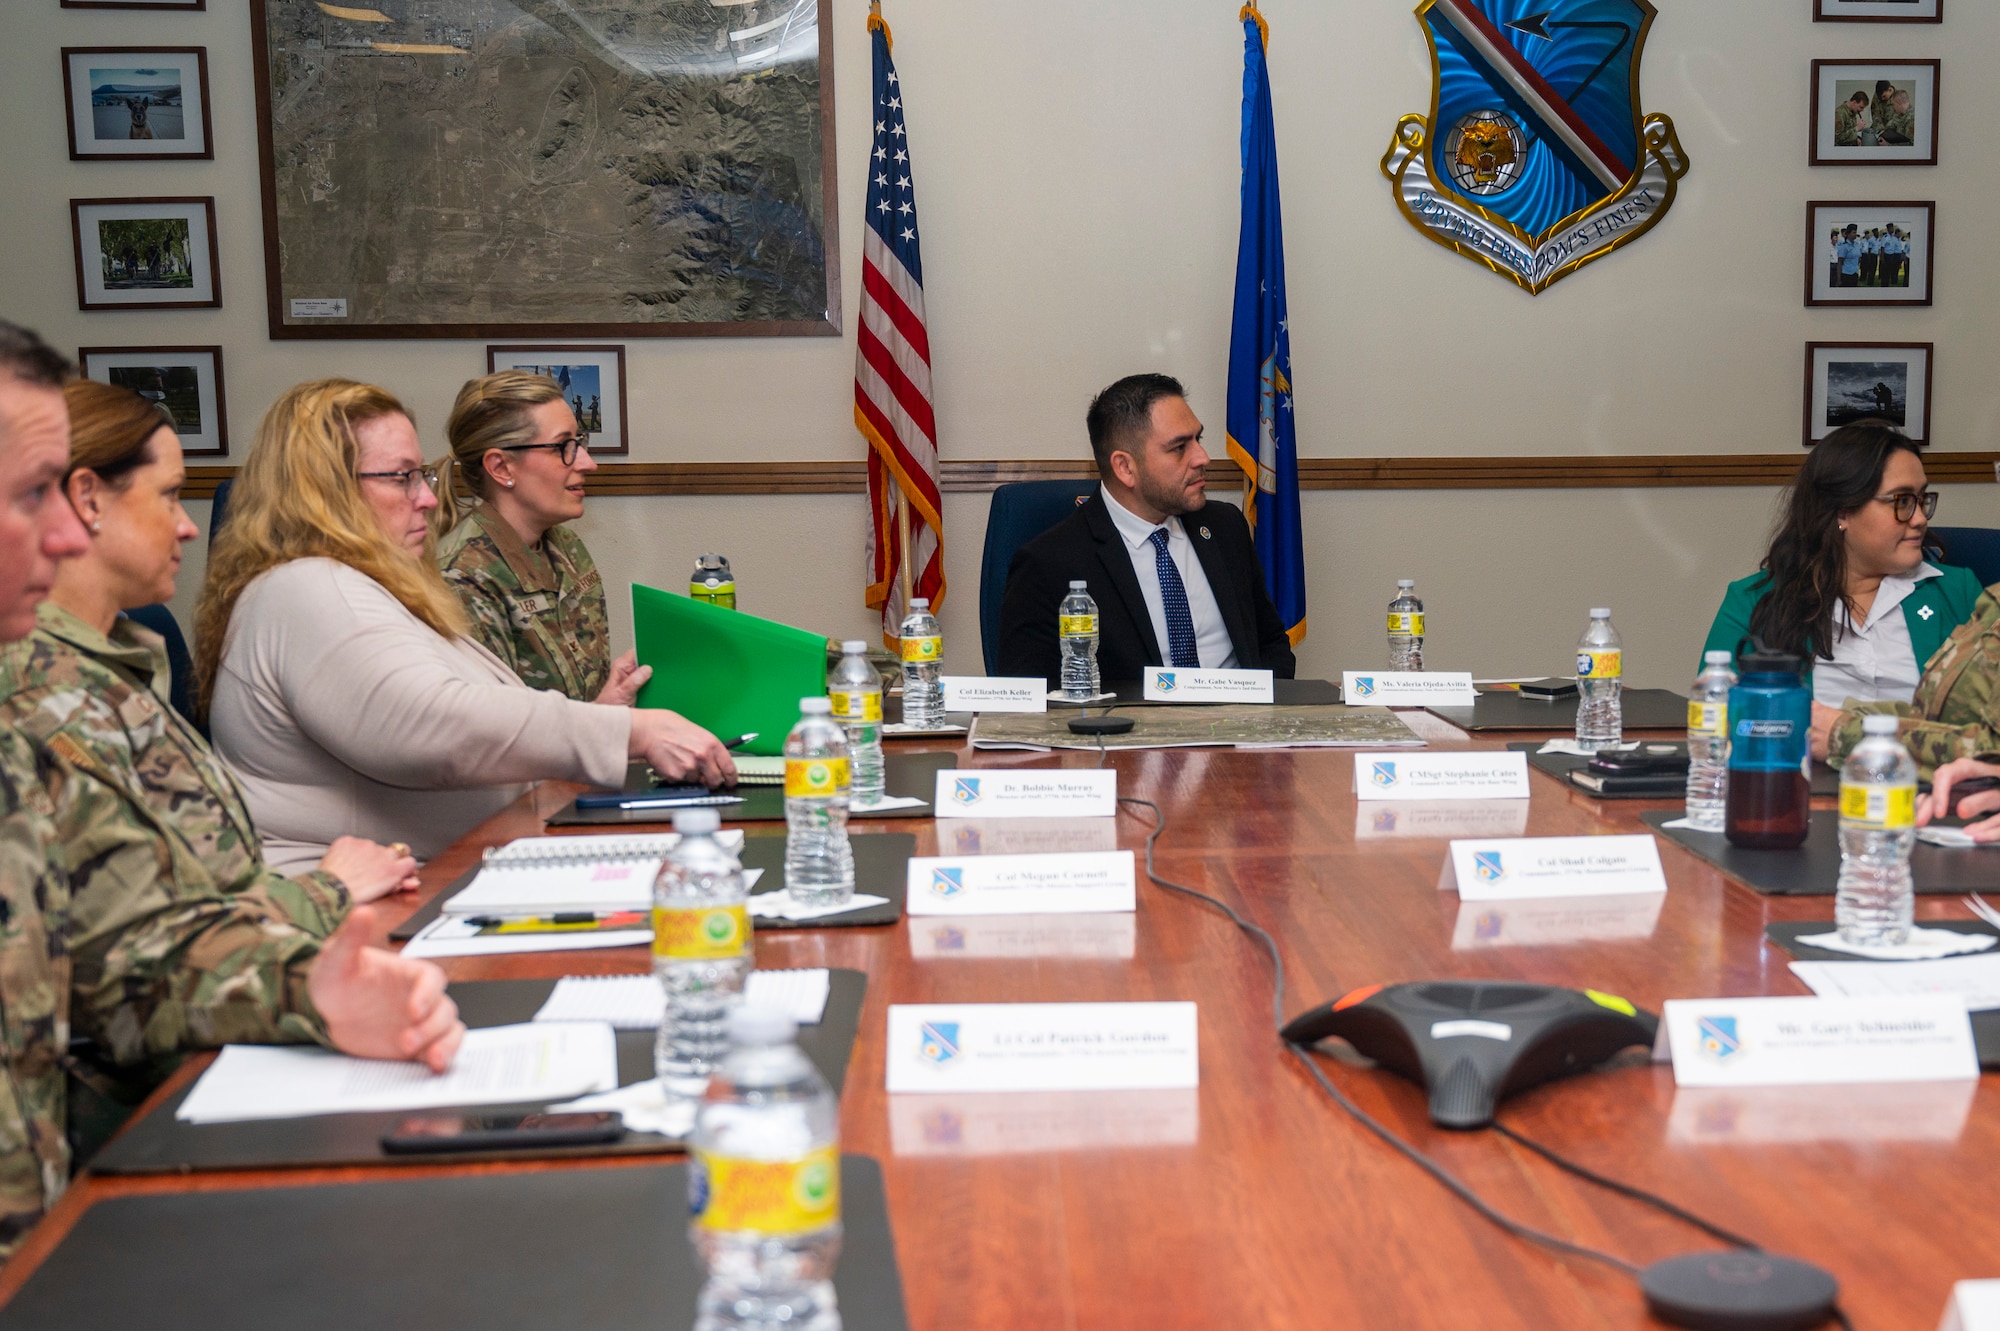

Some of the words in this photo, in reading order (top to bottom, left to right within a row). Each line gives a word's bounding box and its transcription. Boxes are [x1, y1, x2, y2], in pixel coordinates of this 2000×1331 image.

[1412, 191, 1485, 247] SERVING
[1490, 228, 1589, 277] FREEDOM'S
[1592, 187, 1656, 237] FINEST
[1409, 770, 1442, 779] CMSgt
[1444, 770, 1489, 779] Stephanie
[1004, 784, 1020, 792] Dr.
[1022, 784, 1053, 792] Bobbie
[1058, 784, 1095, 793] Murray
[995, 873, 1018, 881] Col
[1020, 872, 1061, 882] Megan
